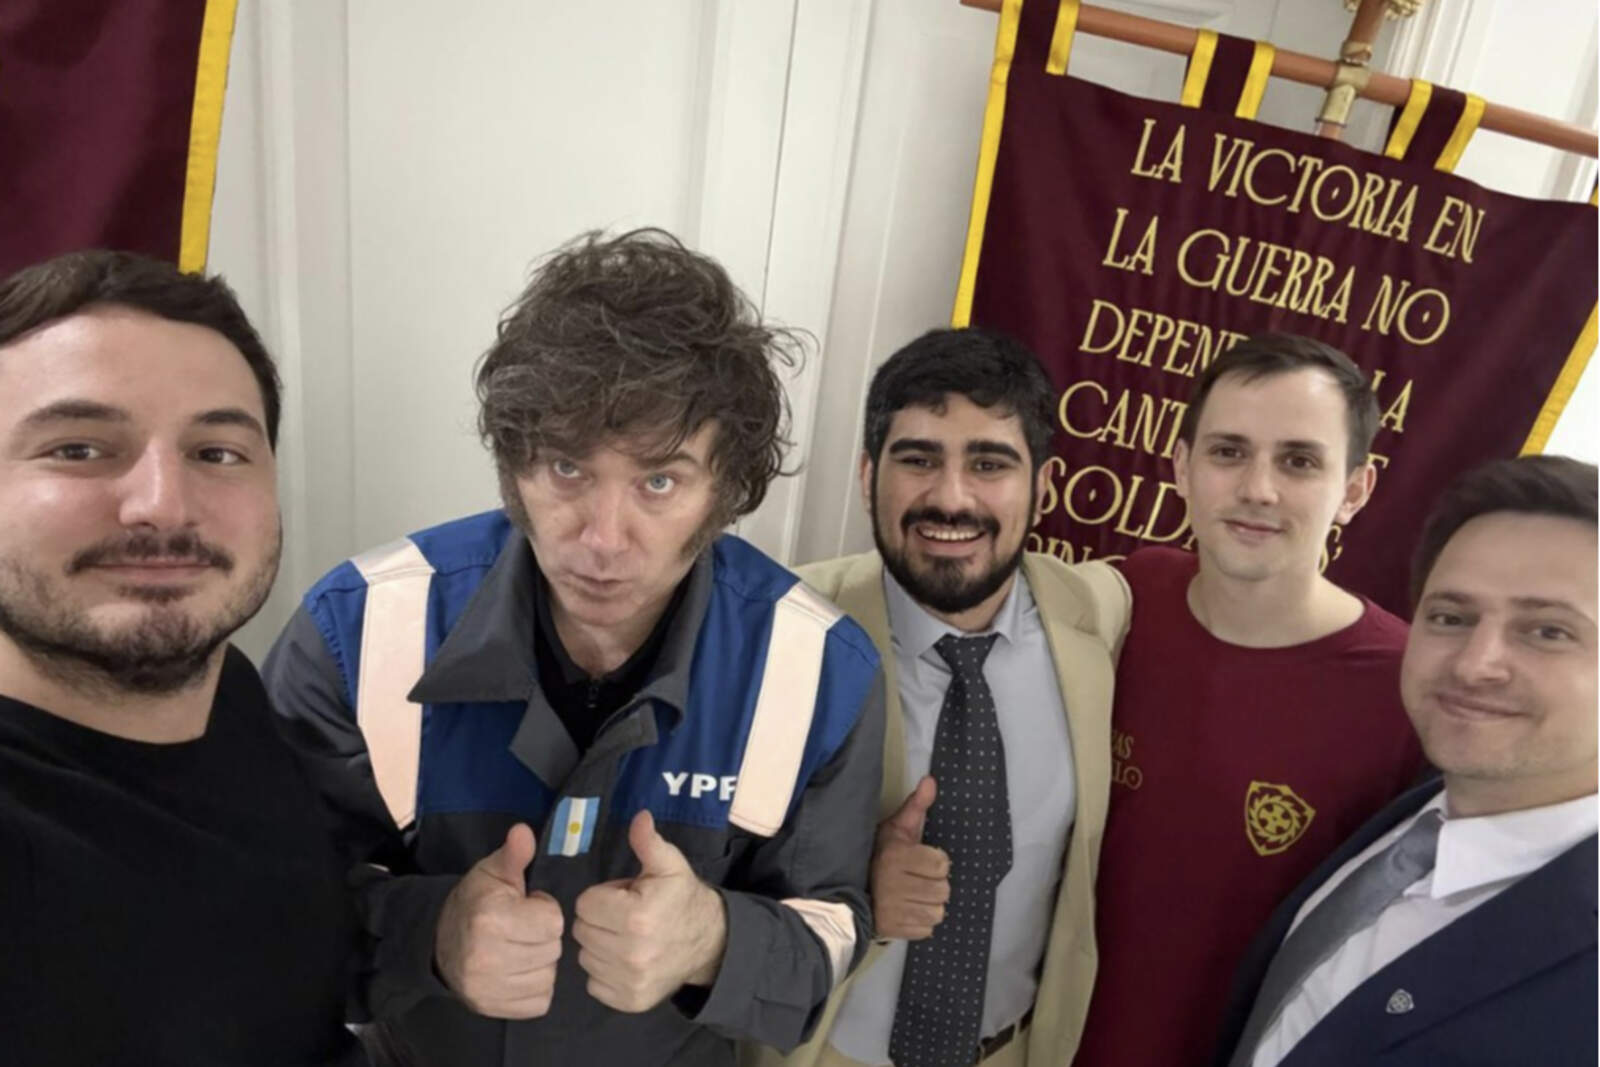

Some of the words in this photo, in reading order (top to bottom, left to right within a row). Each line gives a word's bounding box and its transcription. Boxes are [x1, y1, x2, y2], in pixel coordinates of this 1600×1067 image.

[1130, 118, 1186, 183] LA
[1207, 132, 1420, 243] VICTORIA
[1423, 195, 1486, 264] EN
[1101, 203, 1159, 276] LA
[1176, 228, 1356, 324] GUERRA
[1361, 275, 1450, 345] NO
[1078, 299, 1250, 378] DEPEN
[1058, 380, 1189, 459] CANT
[662, 771, 739, 801] YPF
